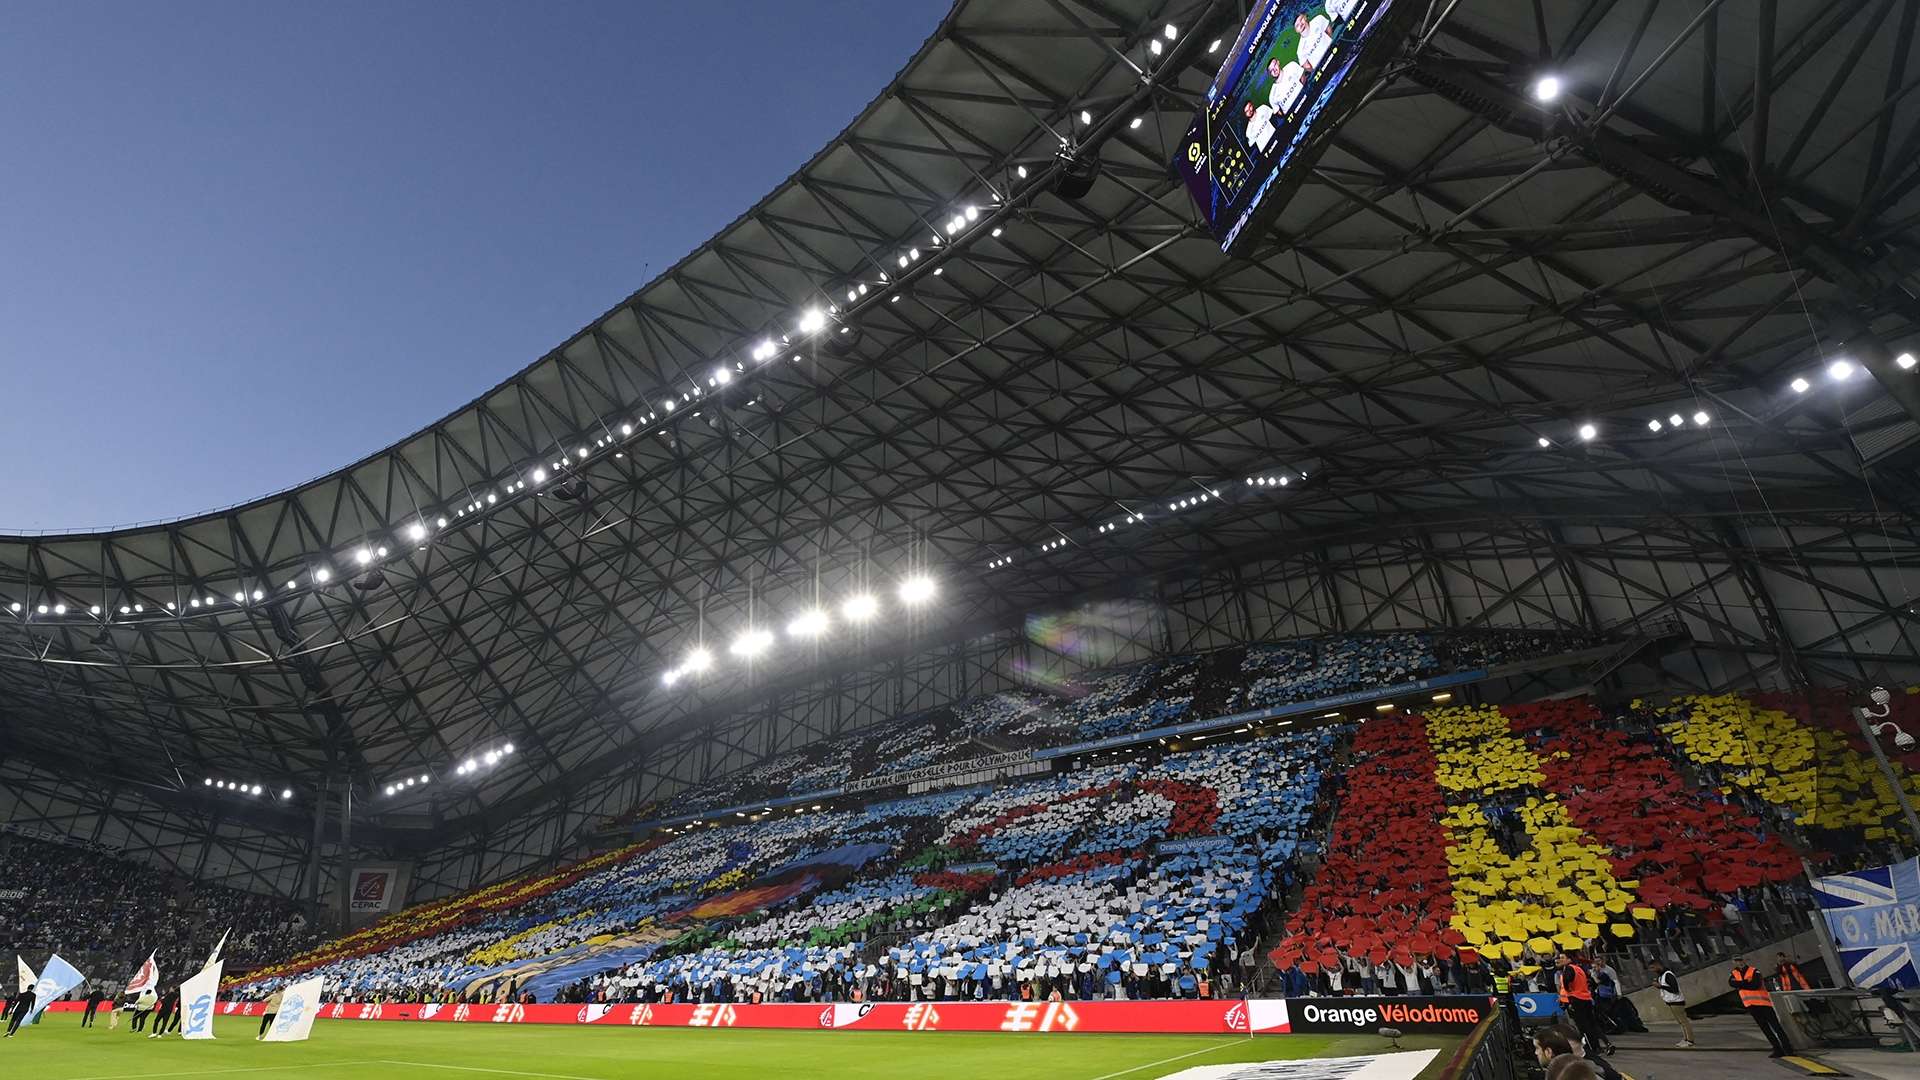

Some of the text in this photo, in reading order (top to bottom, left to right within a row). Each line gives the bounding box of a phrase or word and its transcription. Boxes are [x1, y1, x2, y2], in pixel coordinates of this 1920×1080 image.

[1248, 3, 1278, 54] OLYMPIQUE DE
[844, 748, 1030, 792] UNE FLAMME UNIVERSELLE POUR L'OLYMPIQUE
[1159, 837, 1228, 853] Orange Vélodrome
[351, 901, 382, 909] CEPAC
[1303, 1003, 1479, 1026] Orange Vélodrome
